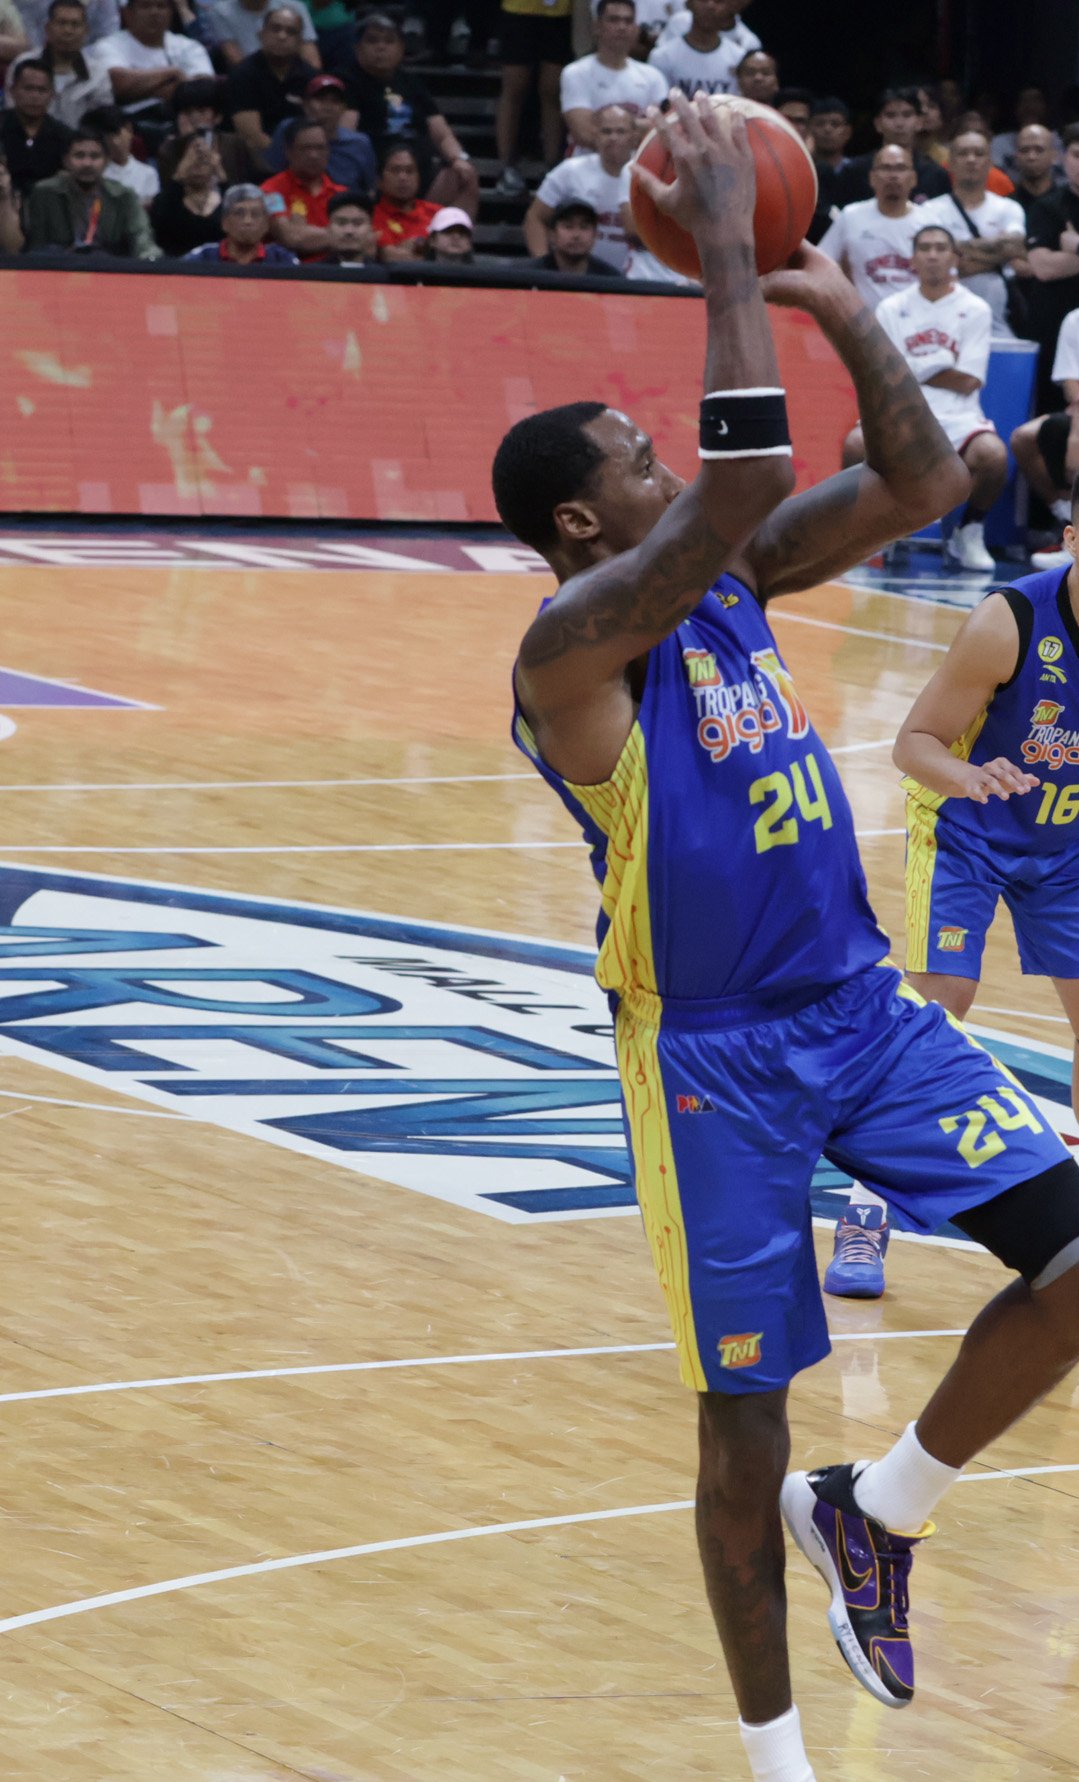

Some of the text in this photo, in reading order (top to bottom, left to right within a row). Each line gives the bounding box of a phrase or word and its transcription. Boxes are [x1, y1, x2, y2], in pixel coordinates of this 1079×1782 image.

[1042, 640, 1060, 659] 17
[698, 699, 781, 763] giga
[1031, 704, 1065, 725] TNT
[749, 753, 833, 854] 24
[937, 929, 969, 950] TNT
[333, 955, 589, 1015] MALL
[938, 1086, 1044, 1169] 24
[717, 1331, 763, 1367] TNT
